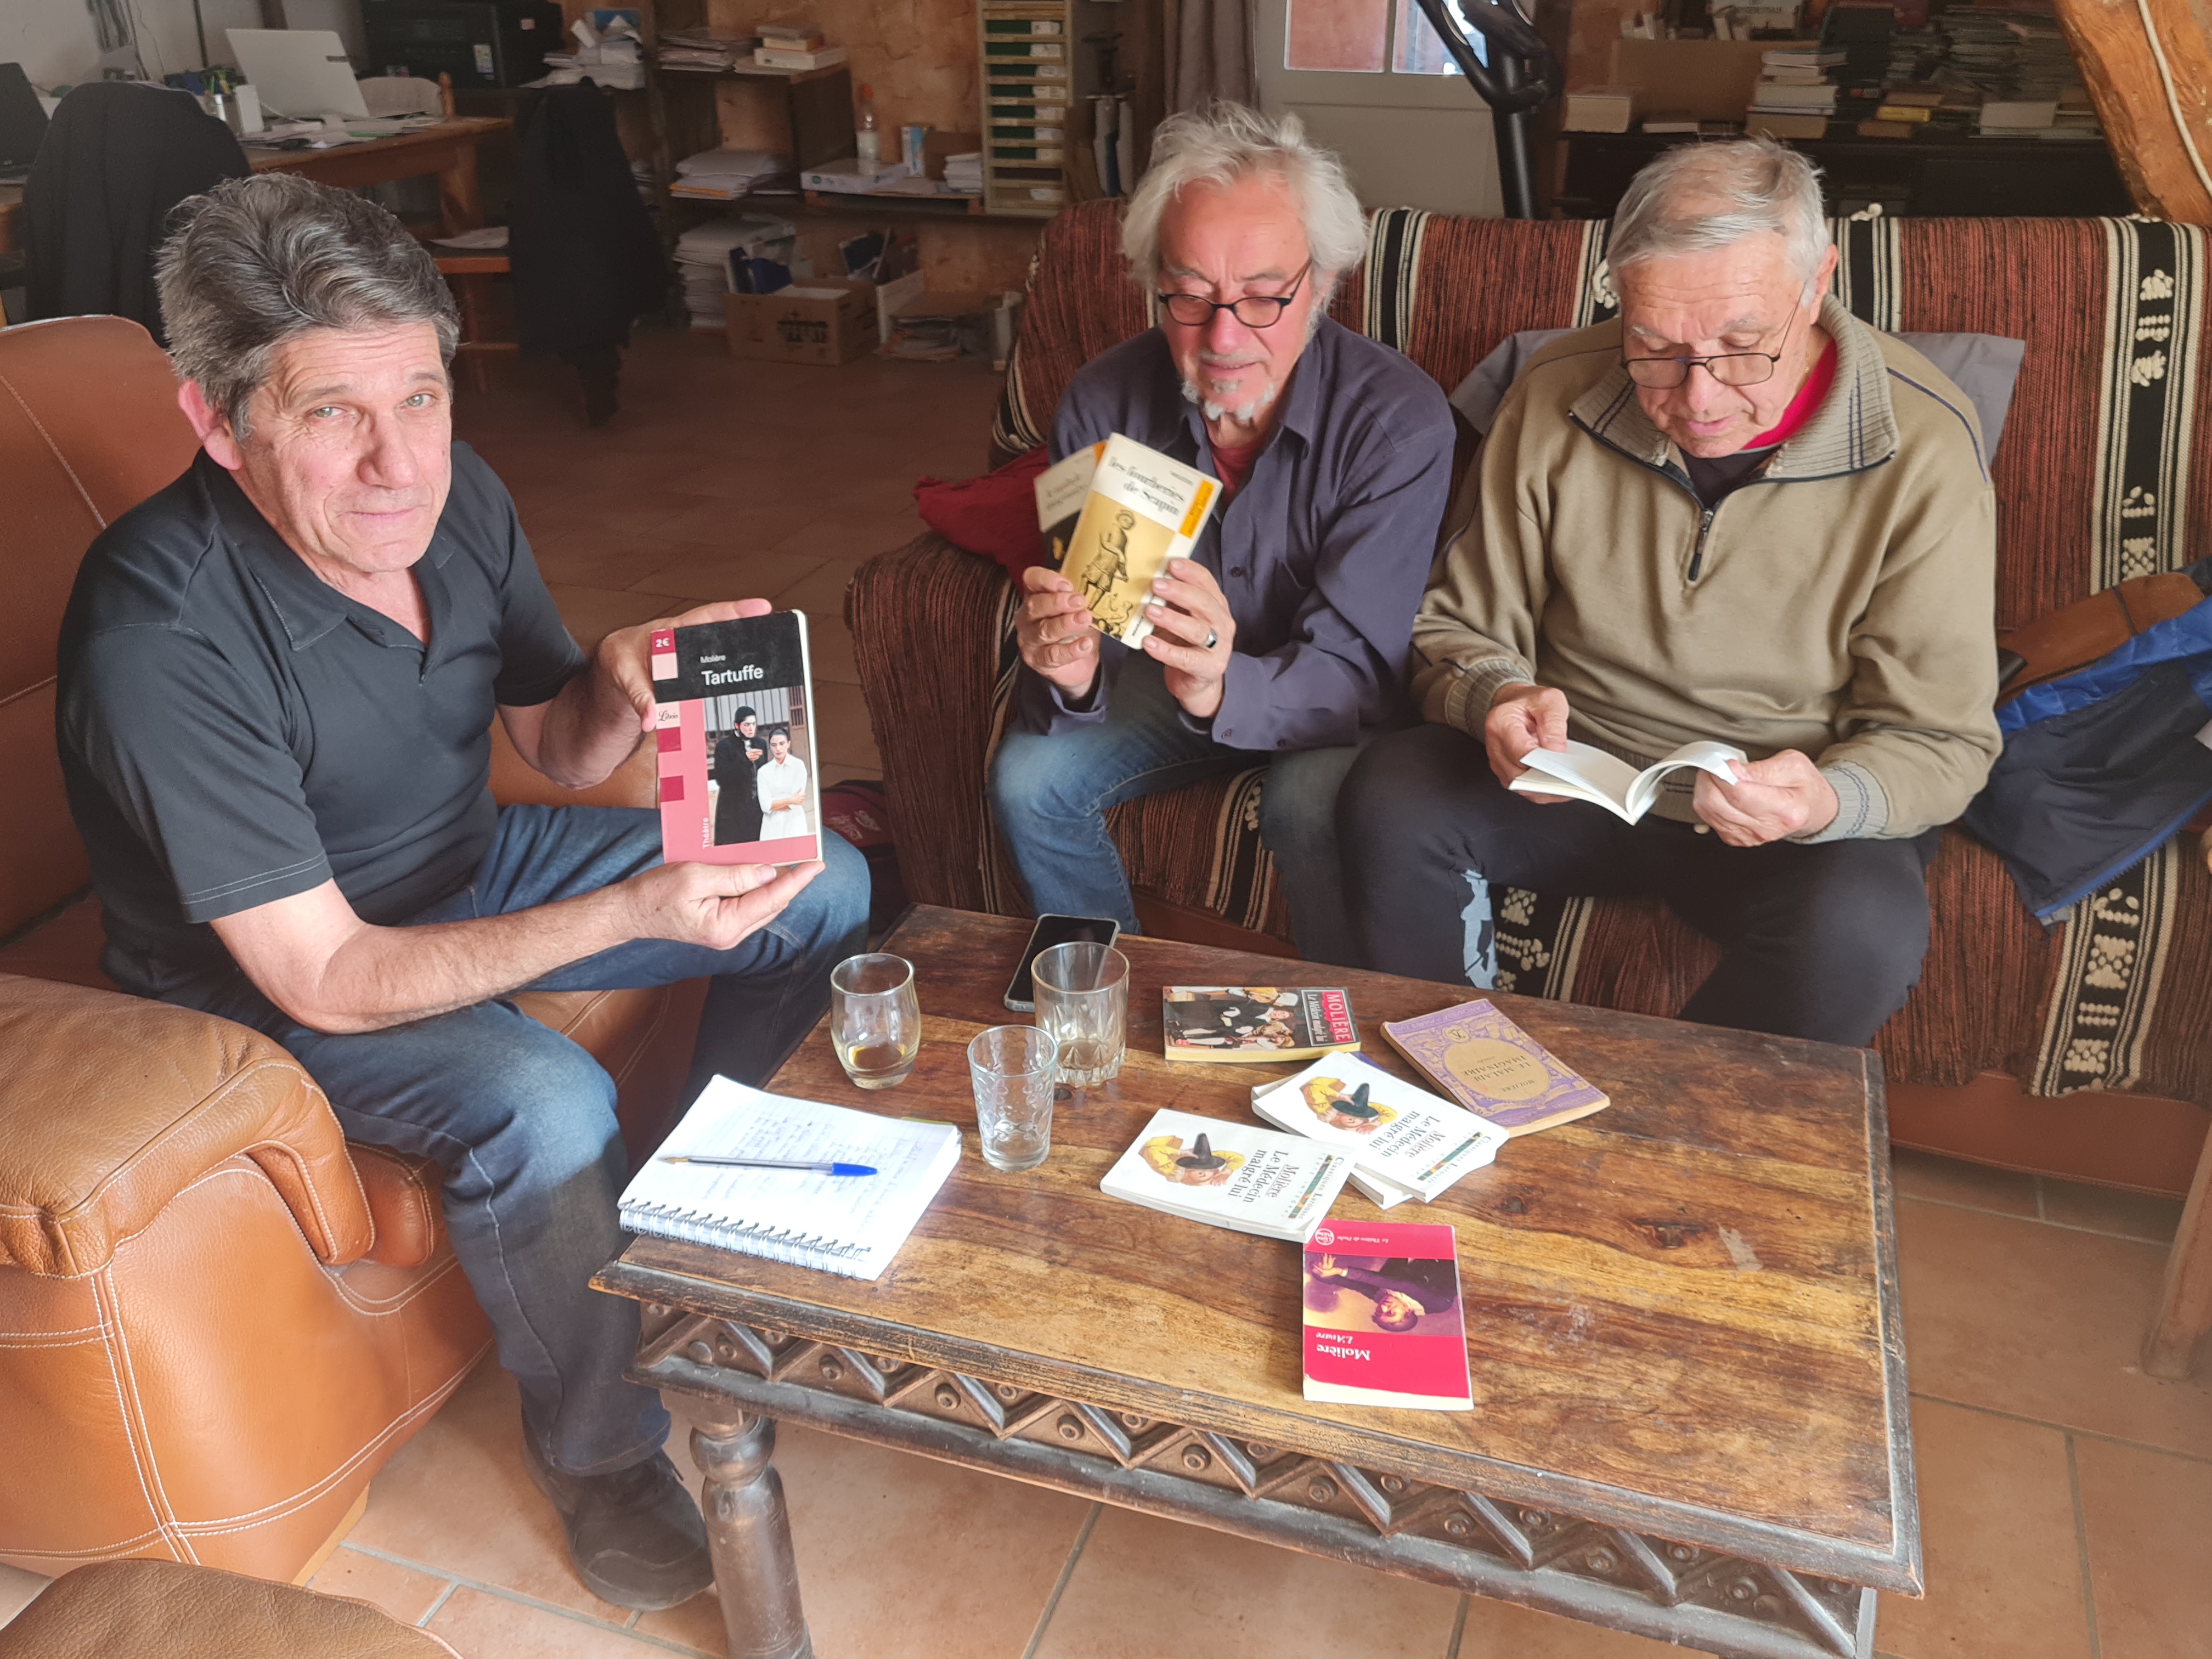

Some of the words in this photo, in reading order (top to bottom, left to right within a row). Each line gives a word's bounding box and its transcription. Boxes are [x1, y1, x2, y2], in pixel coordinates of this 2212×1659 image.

[656, 637, 670, 648] 2€
[700, 653, 726, 664] Molière
[701, 665, 764, 686] Tartuffe
[1326, 994, 1351, 1041] MOLIÈRE
[1460, 1054, 1526, 1078] IMAGINAIRE
[1471, 1065, 1514, 1083] MALADE
[1517, 1060, 1531, 1069] LE
[1383, 1110, 1421, 1141] malgré
[1421, 1115, 1441, 1128] Le
[1368, 1135, 1389, 1153] lui
[1380, 1125, 1425, 1159] Médecin
[1406, 1130, 1446, 1160] Molière
[1455, 1135, 1492, 1163] Classiques
[1237, 1149, 1267, 1184] malgré
[1270, 1150, 1289, 1164] Le
[1243, 1165, 1279, 1204] Médecin
[1267, 1164, 1300, 1199] Molière
[1318, 1156, 1345, 1192] Classiques
[1426, 1161, 1458, 1185] Larousse
[1229, 1182, 1248, 1198] lui
[1299, 1192, 1323, 1220] Larousse
[1316, 1331, 1353, 1345] L'Avare
[1316, 1344, 1371, 1361] Molière
